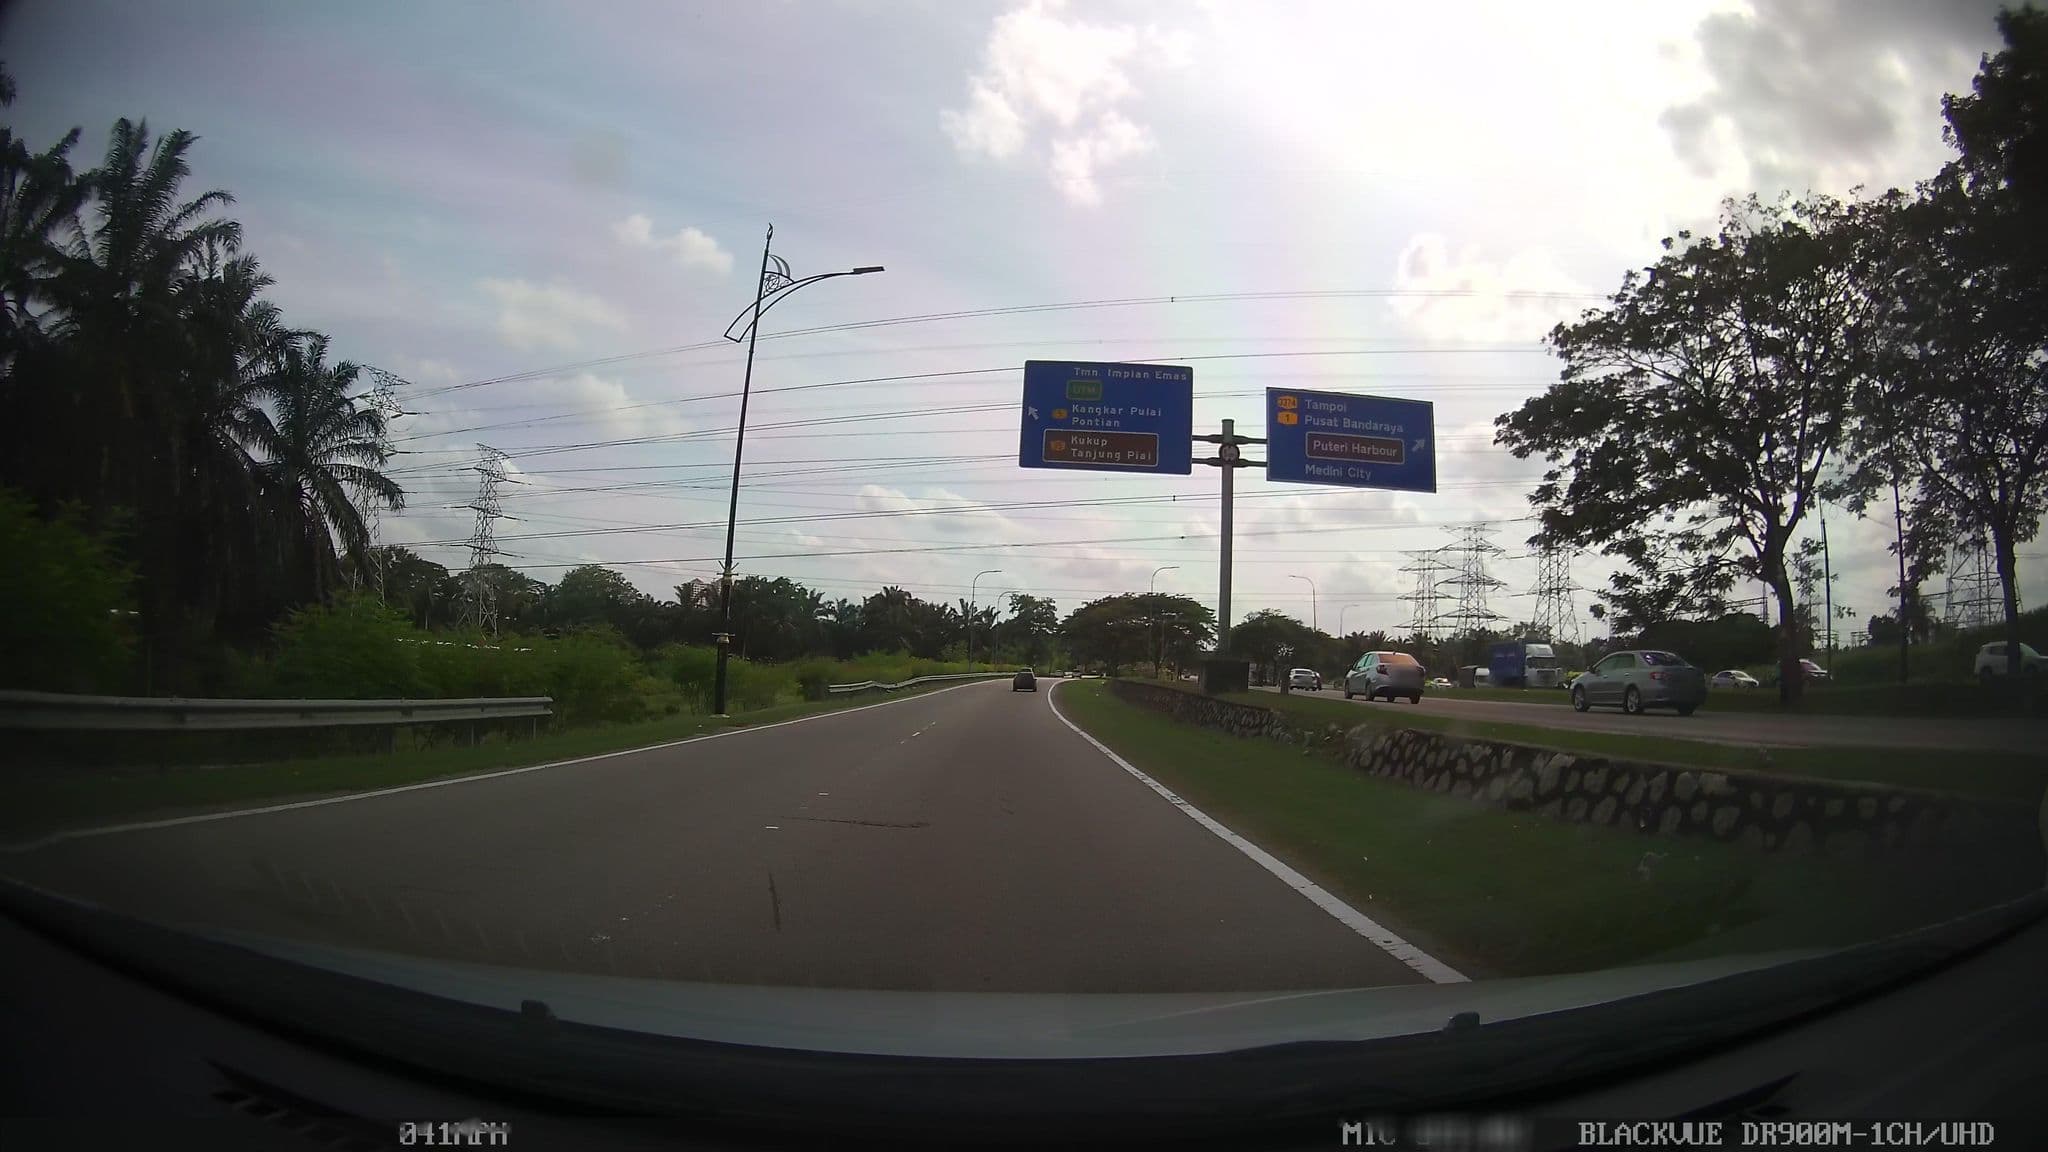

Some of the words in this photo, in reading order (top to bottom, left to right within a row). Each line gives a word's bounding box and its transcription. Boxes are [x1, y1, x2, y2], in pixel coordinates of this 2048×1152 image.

[1108, 368, 1150, 380] Impian
[1154, 370, 1188, 381] Emas
[1072, 404, 1123, 416] Kangkar
[1130, 406, 1161, 417] Pulai
[1305, 400, 1347, 412] Tampoi
[1072, 417, 1120, 428] Pontian
[1304, 415, 1339, 427] Pusat
[1343, 417, 1404, 435] Bandaraya
[1071, 435, 1108, 447] Kukup
[1071, 448, 1121, 461] Tanjung
[1127, 450, 1151, 460] Piai
[1313, 440, 1348, 452] Puteri
[1352, 443, 1398, 456] Harbour
[1305, 464, 1343, 477] Medini
[1348, 467, 1372, 481] City
